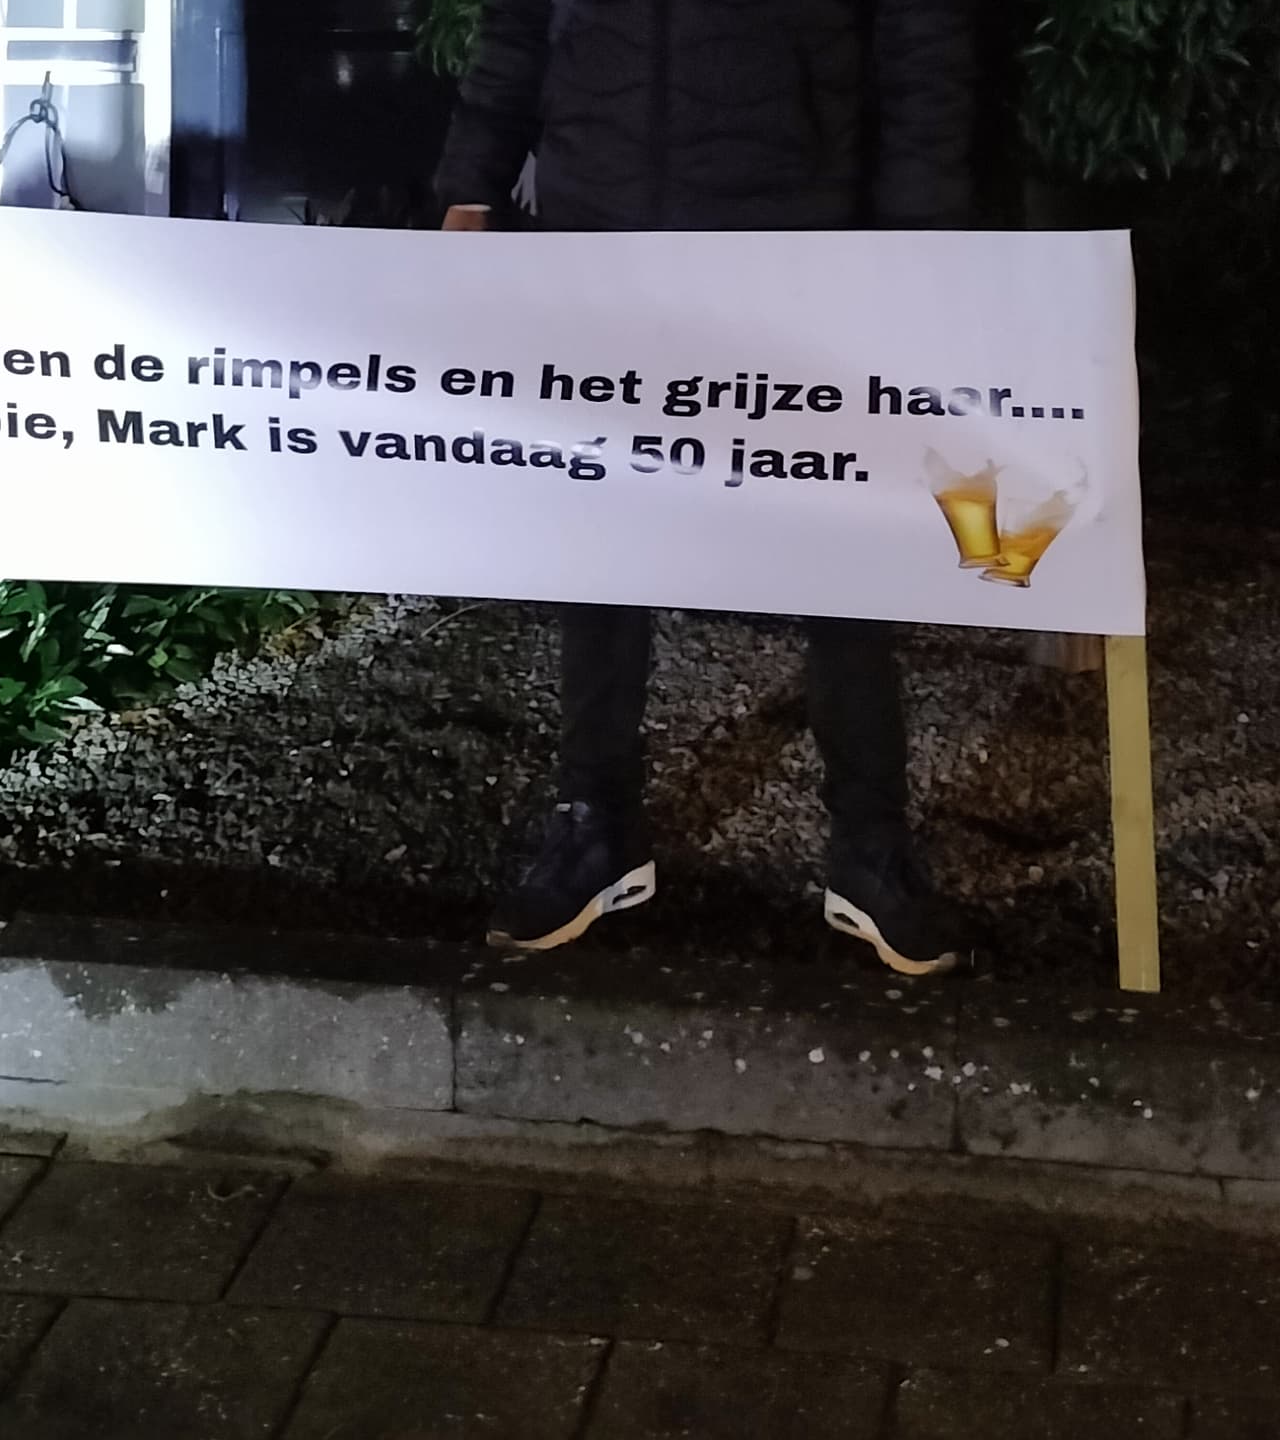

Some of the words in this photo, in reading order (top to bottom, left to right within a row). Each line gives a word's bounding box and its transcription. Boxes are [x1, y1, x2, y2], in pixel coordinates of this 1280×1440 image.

[93, 343, 165, 383] de
[186, 347, 418, 400] rimpels
[439, 367, 515, 398] en
[539, 363, 644, 405] het
[661, 371, 843, 421] grijze
[96, 407, 249, 452] Mark
[267, 415, 319, 455] is
[337, 427, 609, 482] vandaag
[629, 434, 706, 474] 50
[723, 437, 870, 488] jaar.
